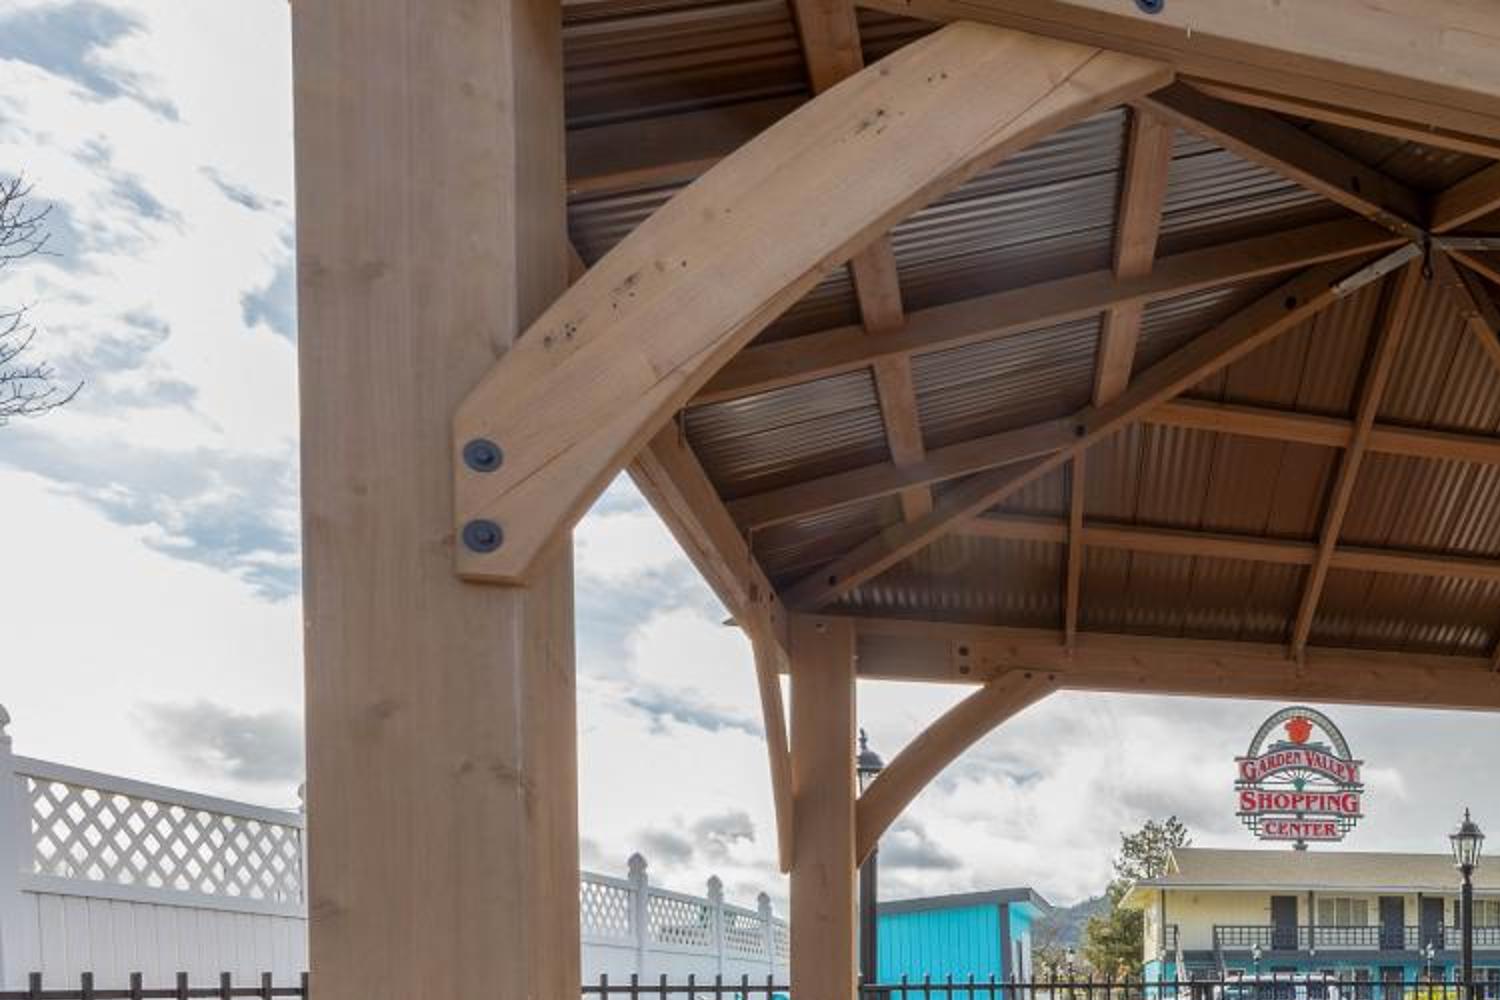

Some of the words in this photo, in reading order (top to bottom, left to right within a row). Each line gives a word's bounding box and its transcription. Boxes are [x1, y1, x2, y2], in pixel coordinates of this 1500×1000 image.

[1241, 751, 1300, 781] GARDEN
[1305, 751, 1357, 783] VALLEY
[1241, 791, 1358, 813] SHOPPING
[1265, 822, 1337, 836] CENTER
